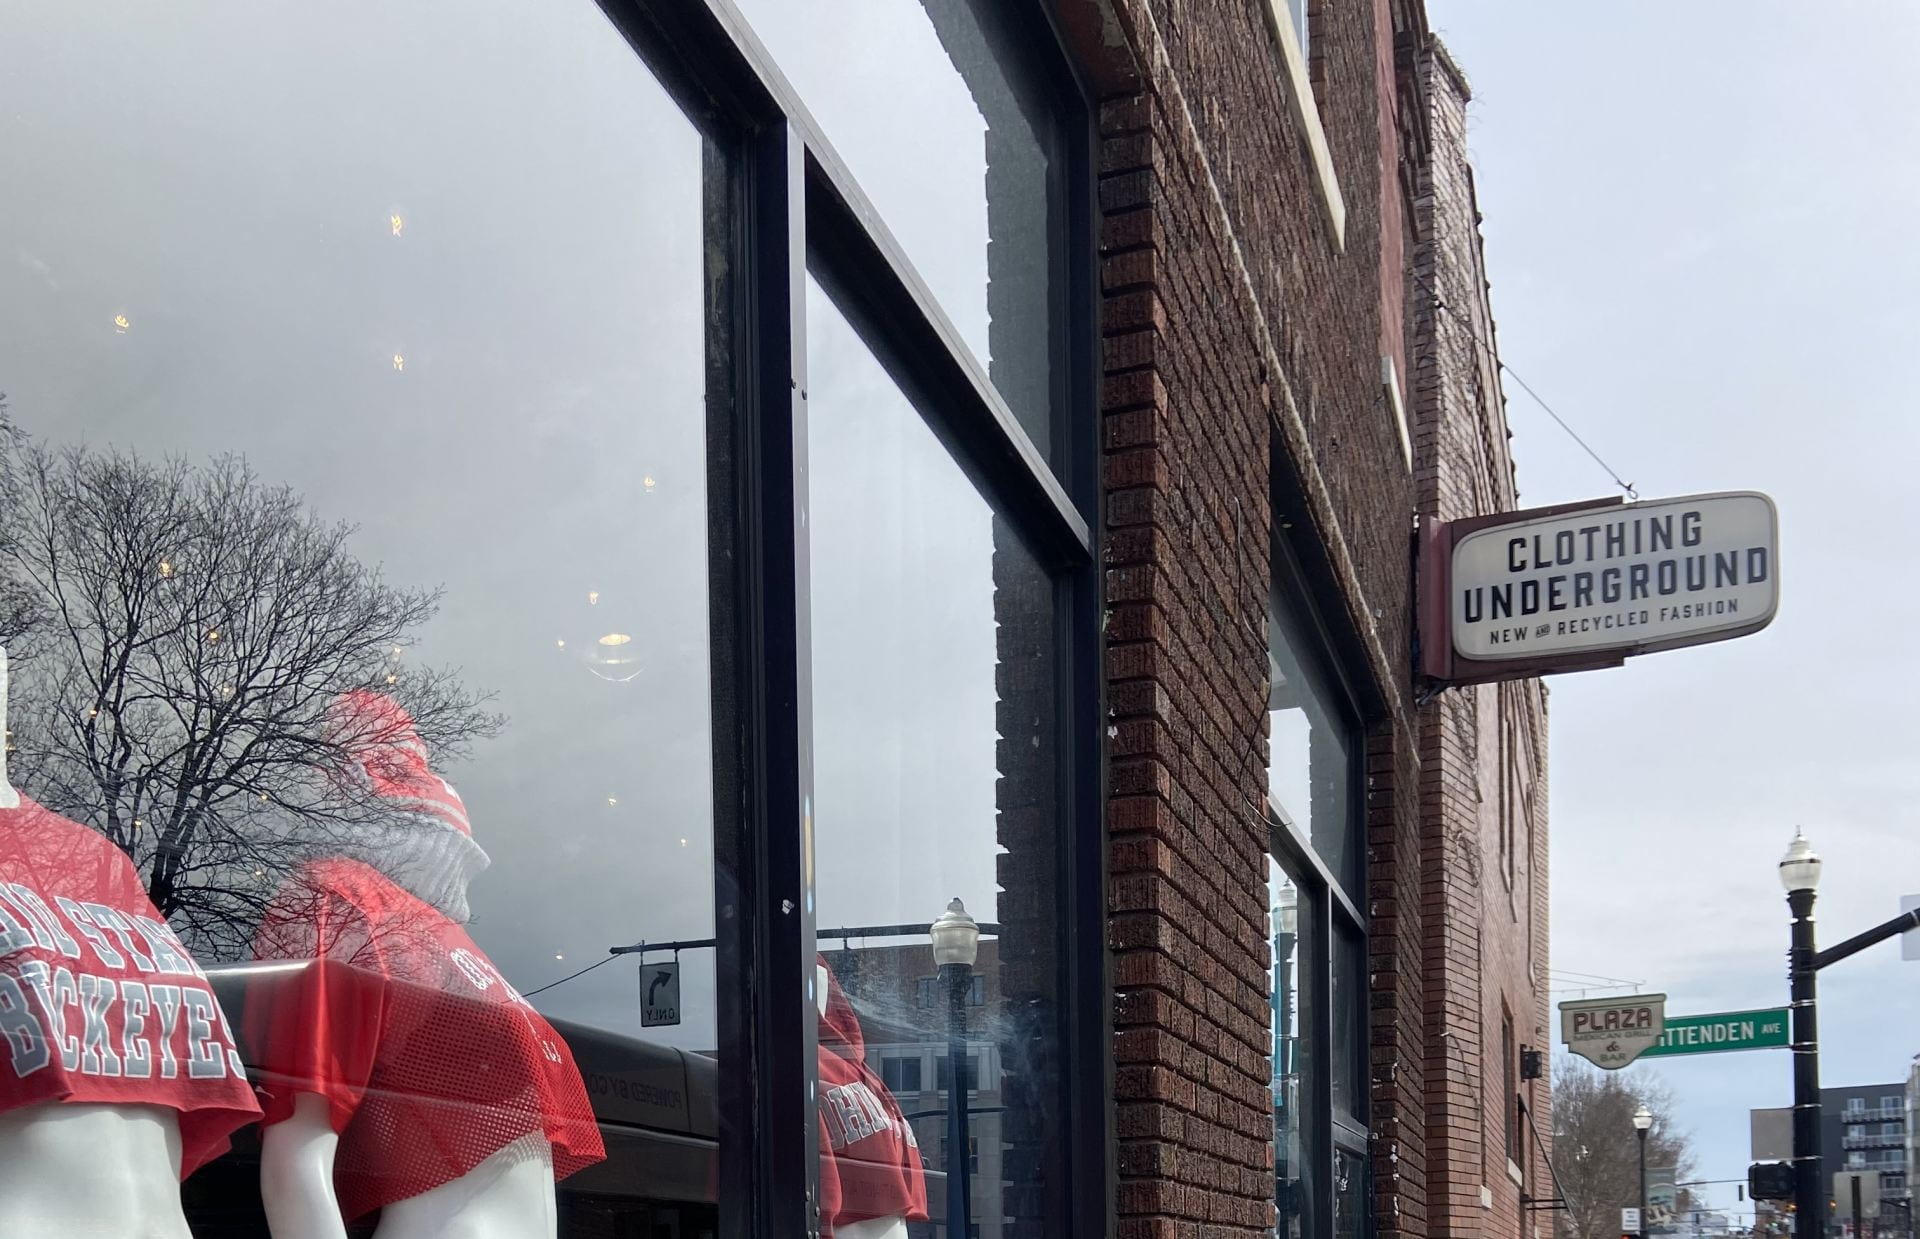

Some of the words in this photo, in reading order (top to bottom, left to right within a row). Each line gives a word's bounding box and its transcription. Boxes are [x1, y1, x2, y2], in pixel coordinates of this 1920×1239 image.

[1508, 511, 1702, 573] CLOTHING
[1464, 547, 1767, 623] UNDERGROUND
[1490, 626, 1528, 644] NEW
[1558, 610, 1649, 636] RECYCLED
[1660, 598, 1739, 622] FASHION
[1573, 1007, 1653, 1033] PLAZA
[1761, 1022, 1781, 1034] AVE
[1600, 1053, 1627, 1062] BAR
[1606, 1041, 1620, 1052] &
